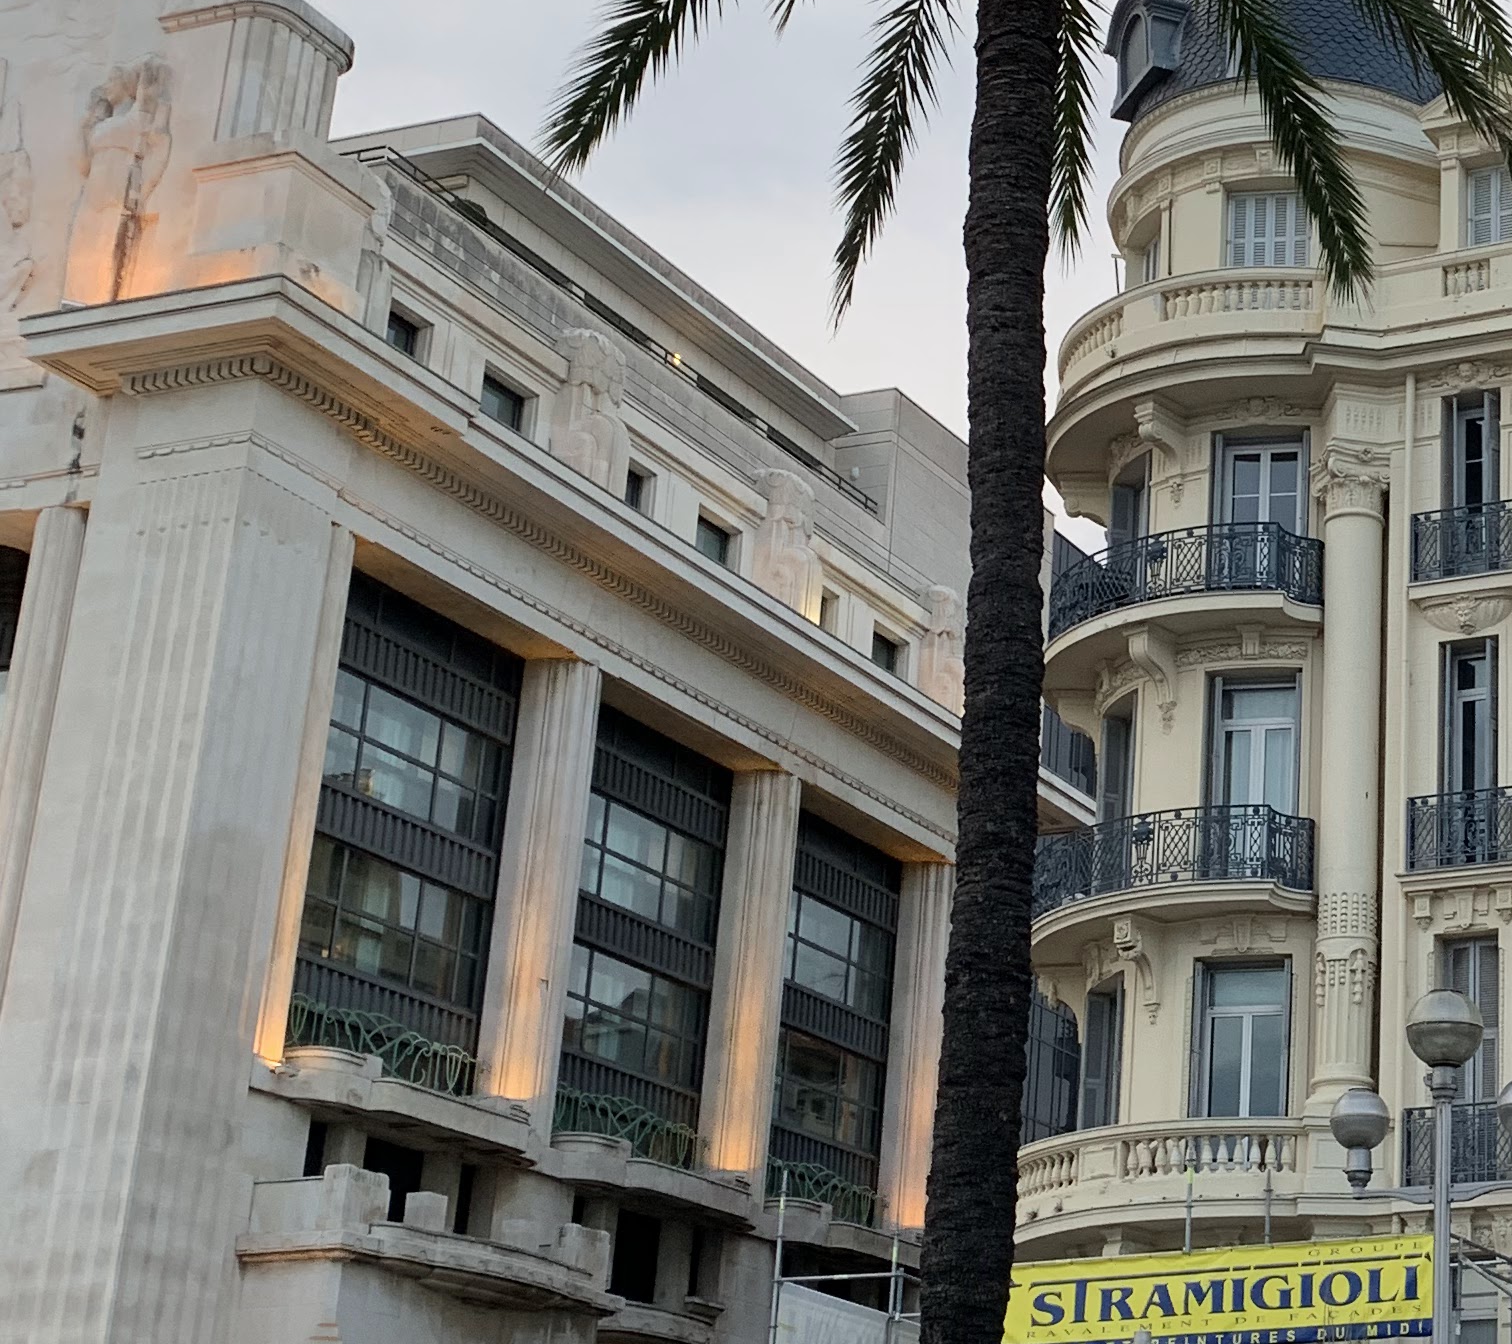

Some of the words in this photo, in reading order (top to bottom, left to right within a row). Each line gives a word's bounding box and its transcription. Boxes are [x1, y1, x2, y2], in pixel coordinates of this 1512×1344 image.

[1308, 1241, 1424, 1257] GROUPE
[1030, 1263, 1421, 1327] STRAMIGIOLI
[1026, 1318, 1214, 1338] RAVALEMENT
[1234, 1316, 1266, 1325] DE
[1316, 1327, 1345, 1340] DU
[1367, 1321, 1423, 1337] MIDI
